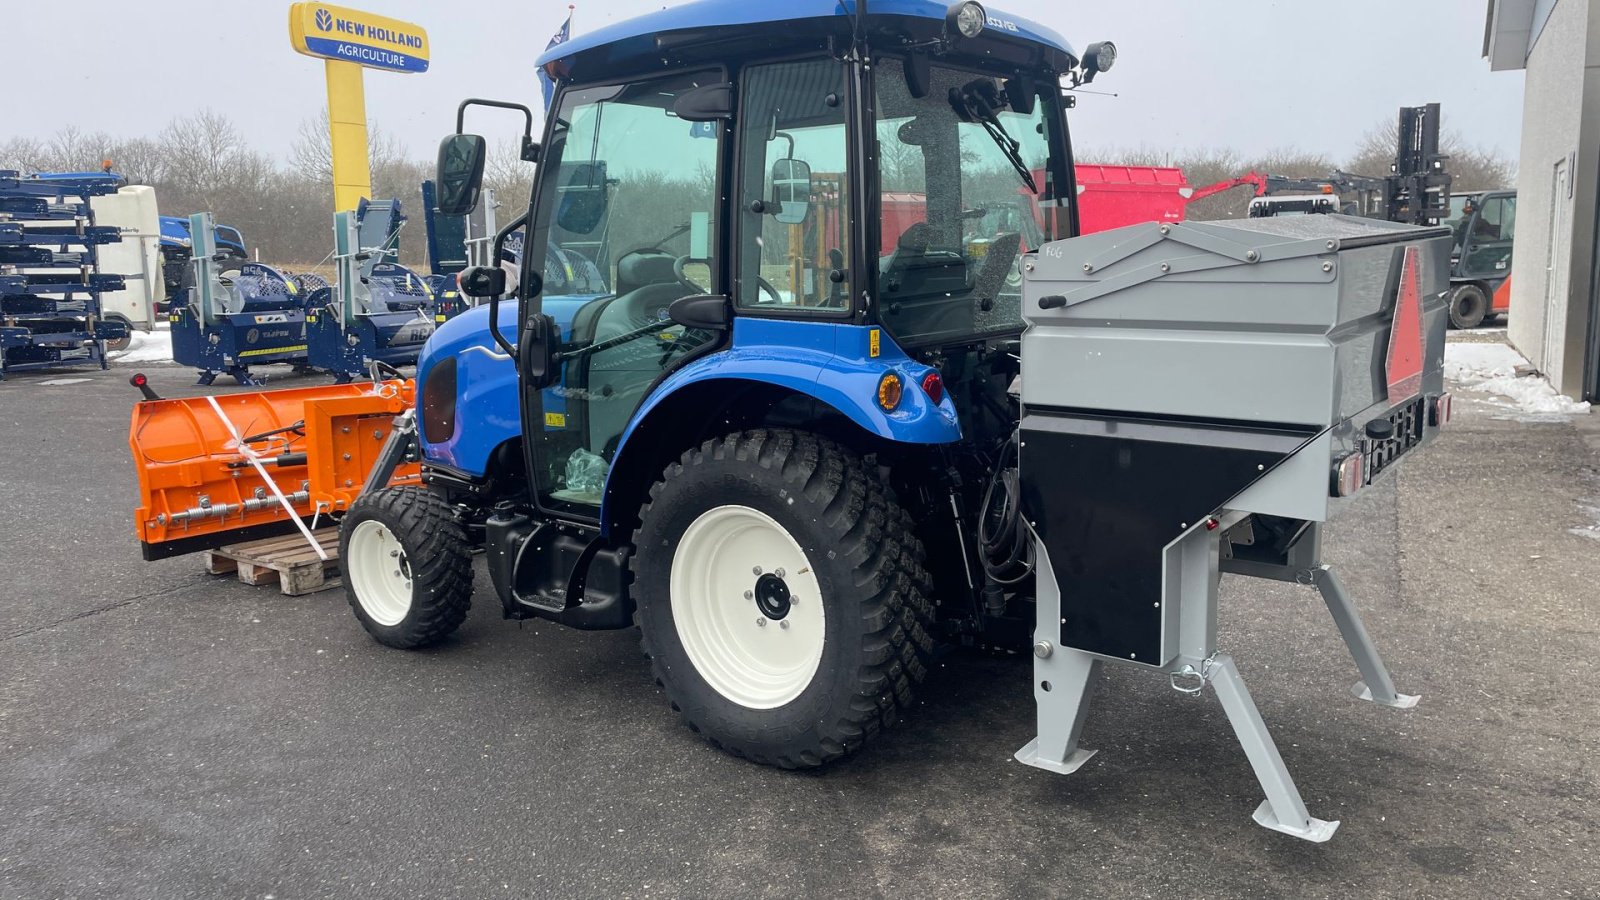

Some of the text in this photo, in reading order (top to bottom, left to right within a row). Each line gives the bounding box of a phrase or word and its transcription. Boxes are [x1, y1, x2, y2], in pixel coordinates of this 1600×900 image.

[336, 19, 422, 49] NEW HOLLAND
[337, 43, 405, 66] AGRICULTURE
